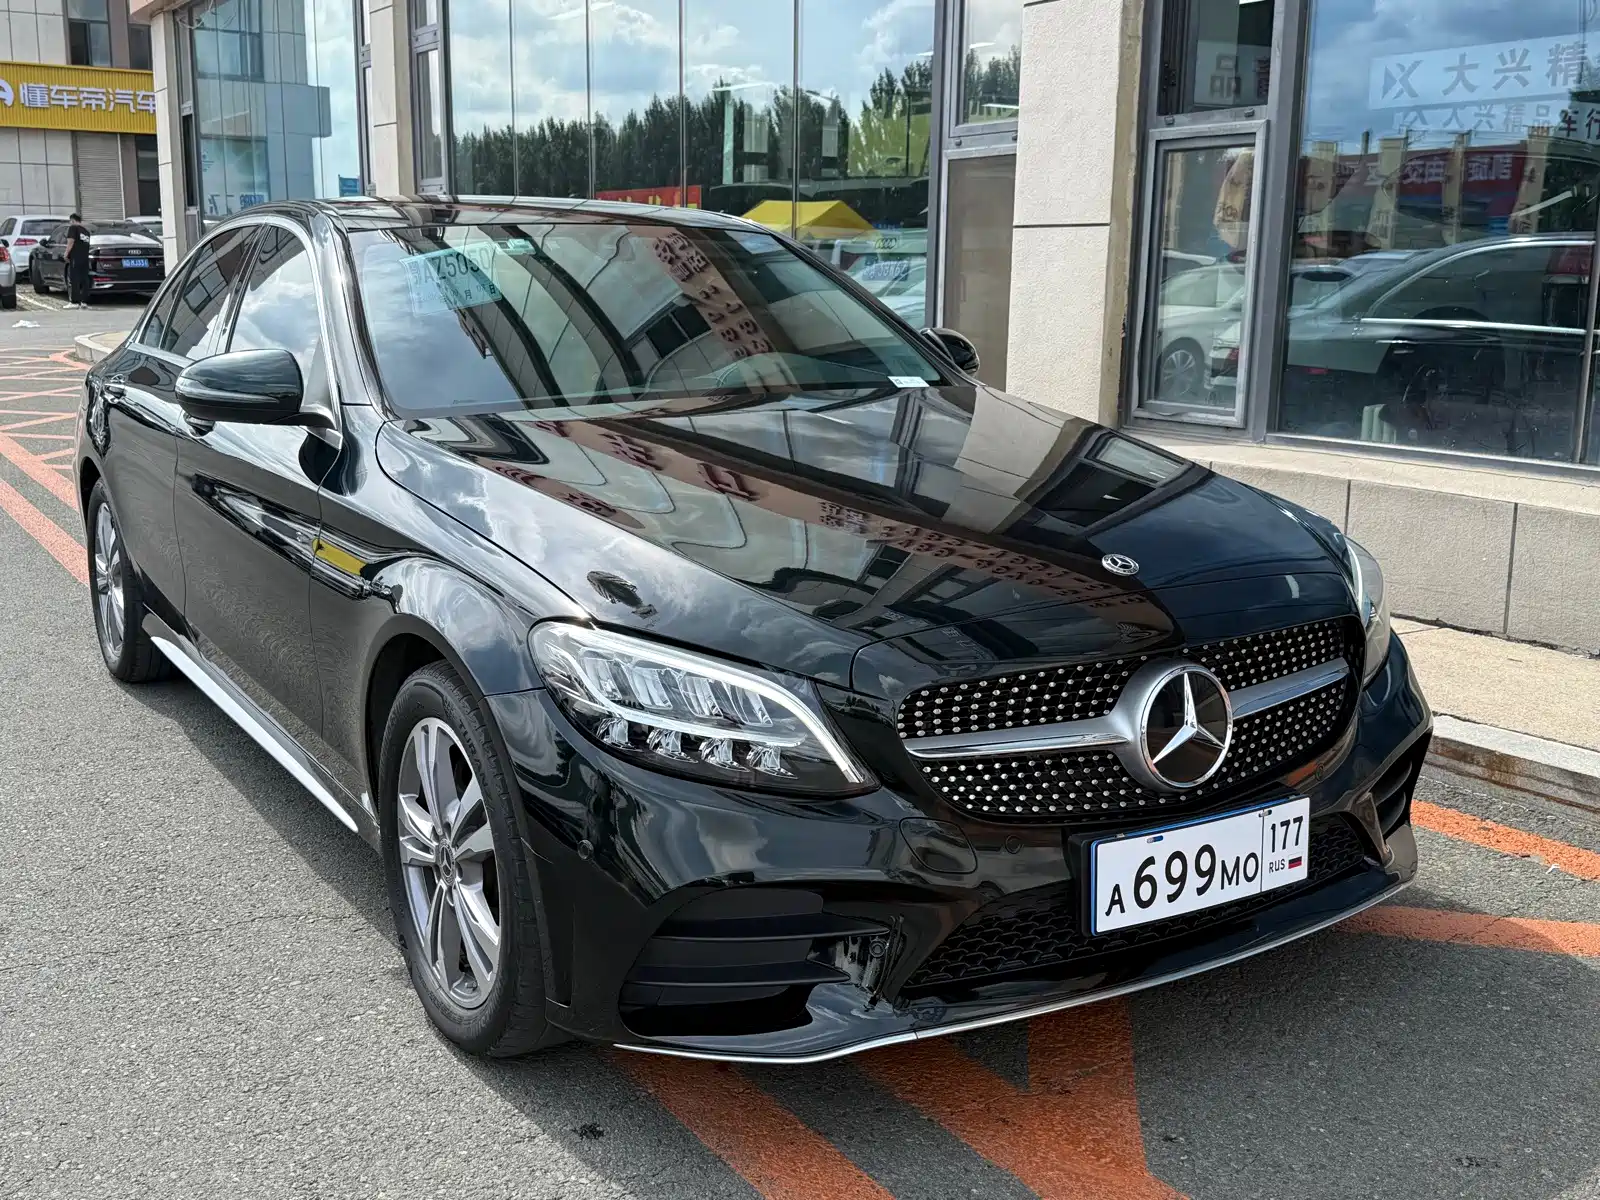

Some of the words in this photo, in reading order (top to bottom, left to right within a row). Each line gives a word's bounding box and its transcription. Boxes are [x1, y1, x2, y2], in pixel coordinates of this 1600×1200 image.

[19, 83, 156, 114] 懂车帝汽车
[1270, 815, 1304, 853] 177
[1268, 858, 1286, 874] RUS
